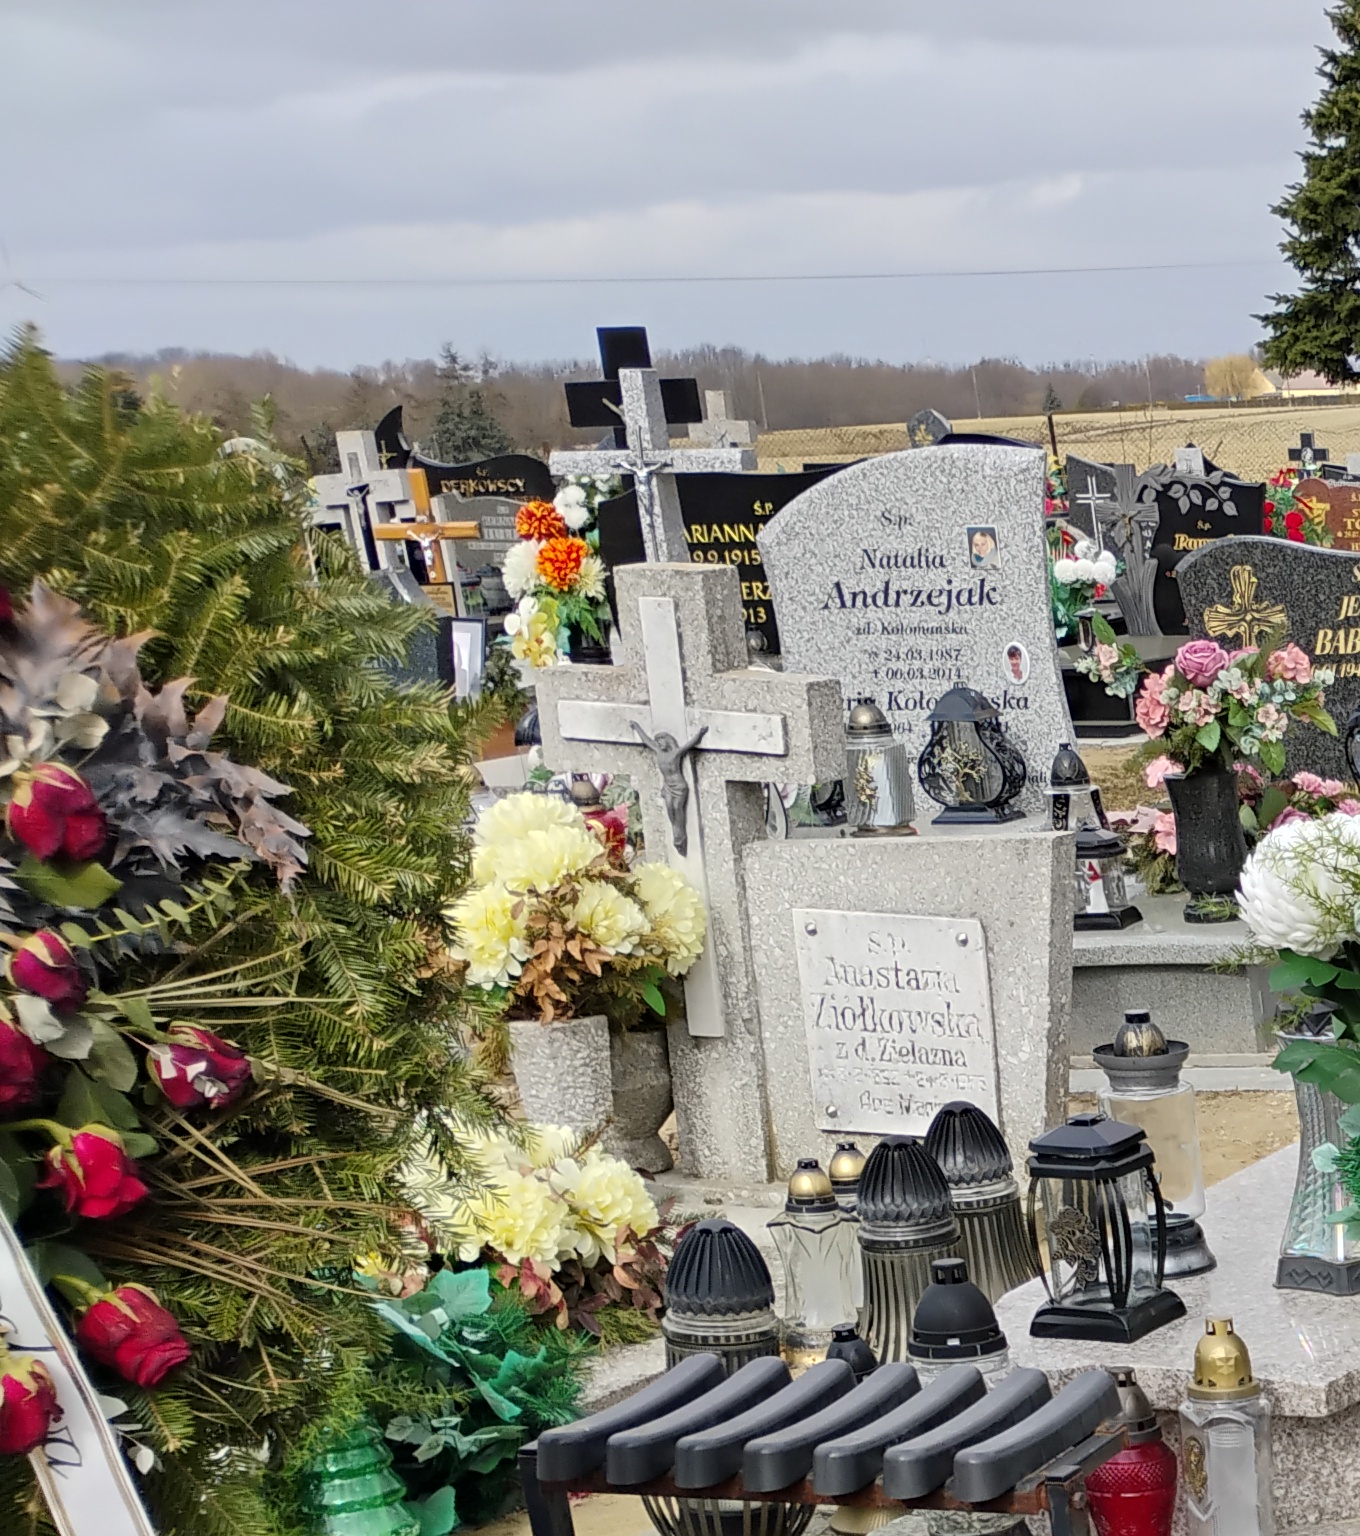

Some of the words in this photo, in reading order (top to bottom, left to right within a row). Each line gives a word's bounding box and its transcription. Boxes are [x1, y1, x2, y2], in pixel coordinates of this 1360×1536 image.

[860, 549, 948, 570] Natalia
[820, 578, 1000, 615] Andrzejak
[809, 993, 984, 1039] Ziółkowska
